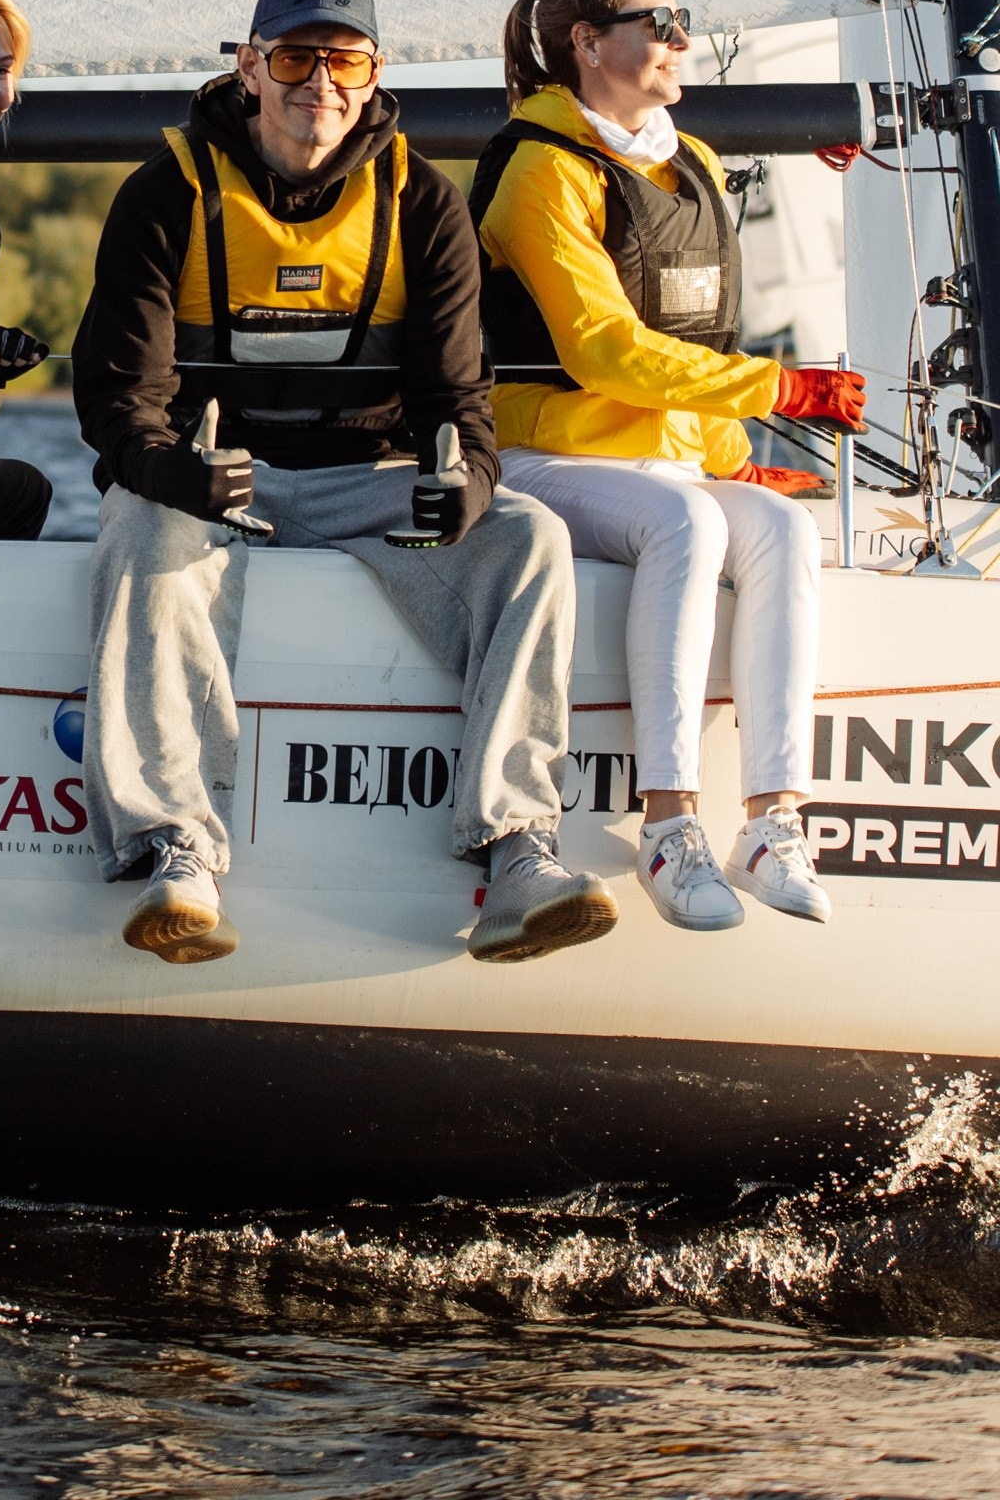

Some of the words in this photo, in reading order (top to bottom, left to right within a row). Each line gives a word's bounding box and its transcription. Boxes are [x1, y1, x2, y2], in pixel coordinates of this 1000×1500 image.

[281, 268, 321, 277] MARINE
[735, 714, 1000, 789] INK
[52, 843, 96, 855] DRIN
